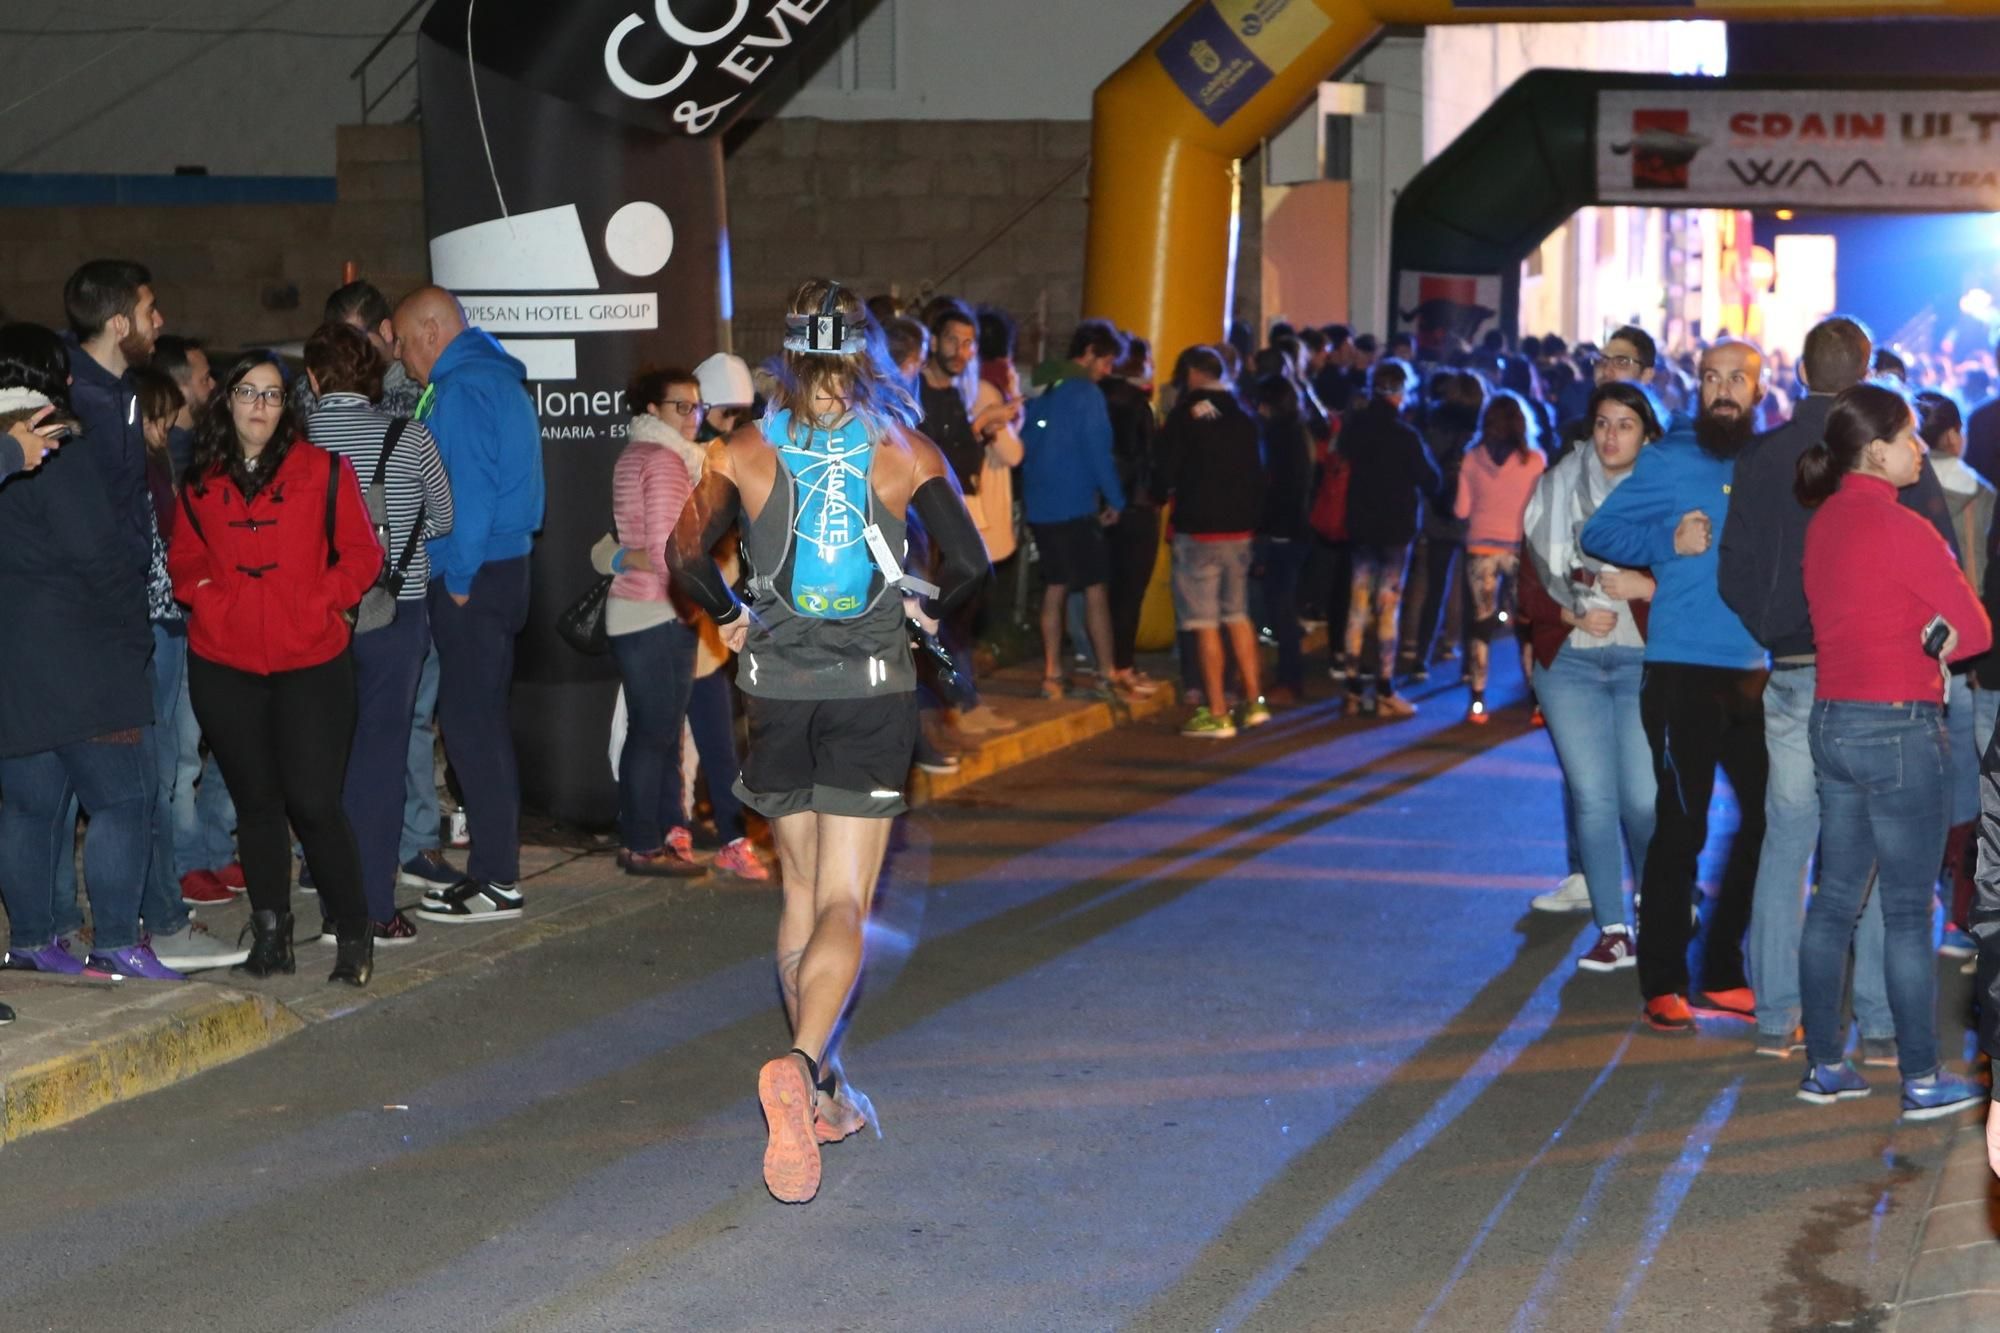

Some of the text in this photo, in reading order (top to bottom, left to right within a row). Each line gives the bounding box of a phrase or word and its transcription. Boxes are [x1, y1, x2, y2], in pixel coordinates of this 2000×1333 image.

[673, 92, 742, 134] &
[1728, 112, 1886, 142] SPAIN
[1908, 171, 1997, 188] ULTRA
[525, 305, 583, 321] HOTEL
[589, 303, 650, 319] GROUP
[530, 383, 631, 416] loner
[541, 426, 596, 439] ANARIA
[610, 424, 631, 438] ES
